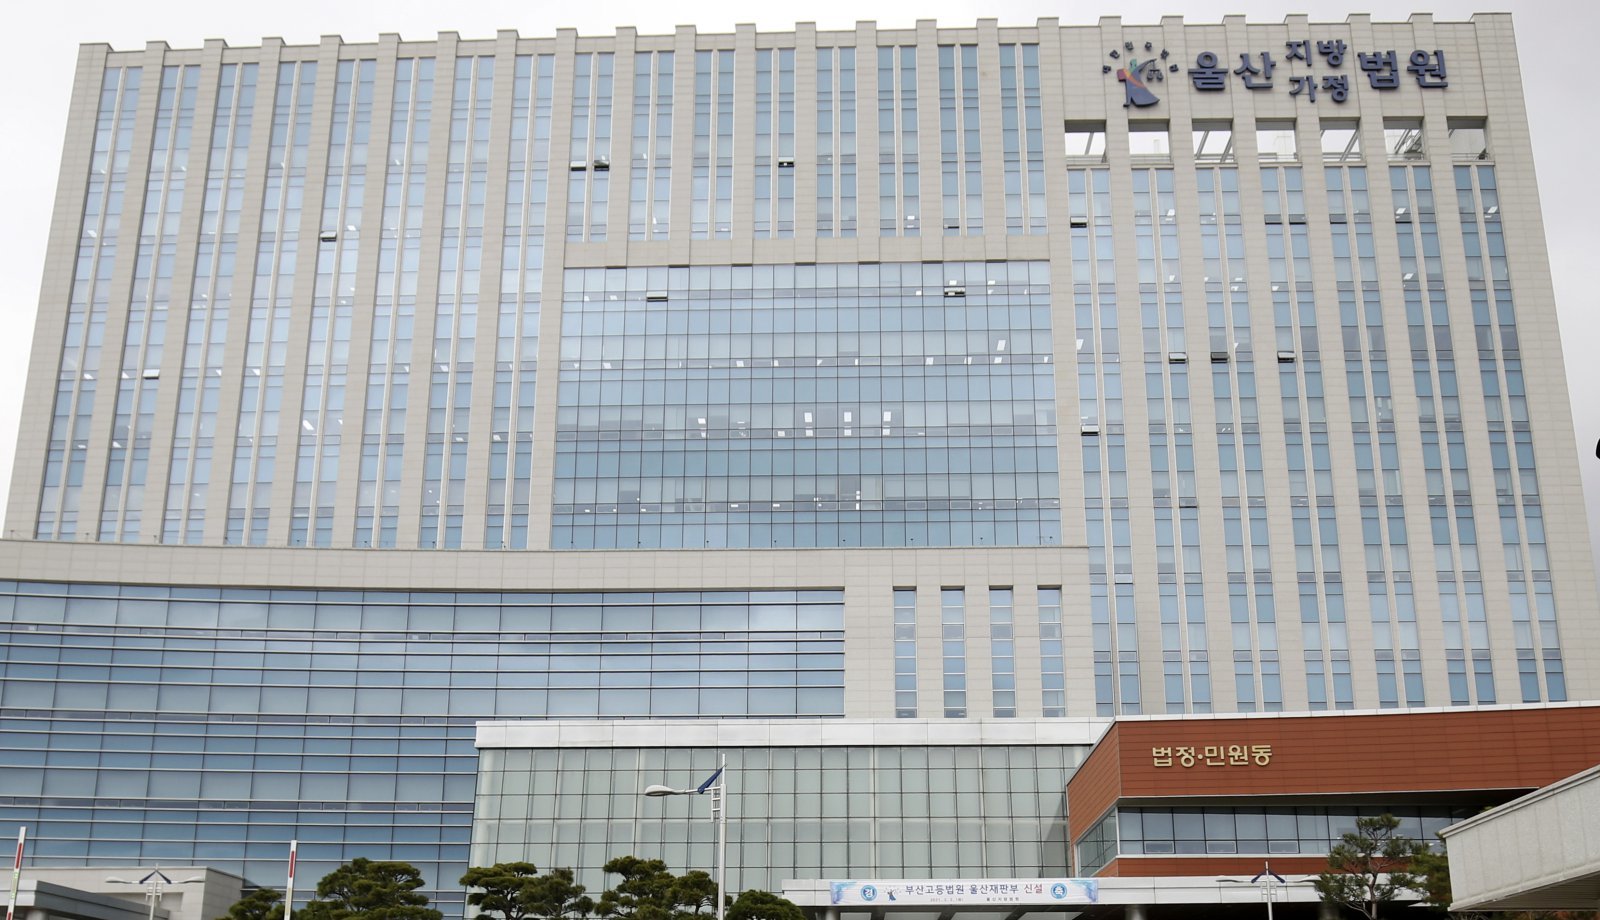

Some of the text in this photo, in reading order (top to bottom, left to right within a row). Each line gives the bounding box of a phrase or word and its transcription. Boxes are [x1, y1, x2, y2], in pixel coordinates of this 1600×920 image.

[1286, 39, 1347, 66] 지방
[1188, 51, 1276, 90] 울산
[1357, 49, 1448, 90] 법원
[1289, 75, 1348, 103] 가정
[1152, 744, 1272, 768] 법정·민원동
[905, 884, 965, 895] 부산고등법원
[969, 884, 1019, 895] 울산재판부
[1023, 883, 1043, 894] 신설
